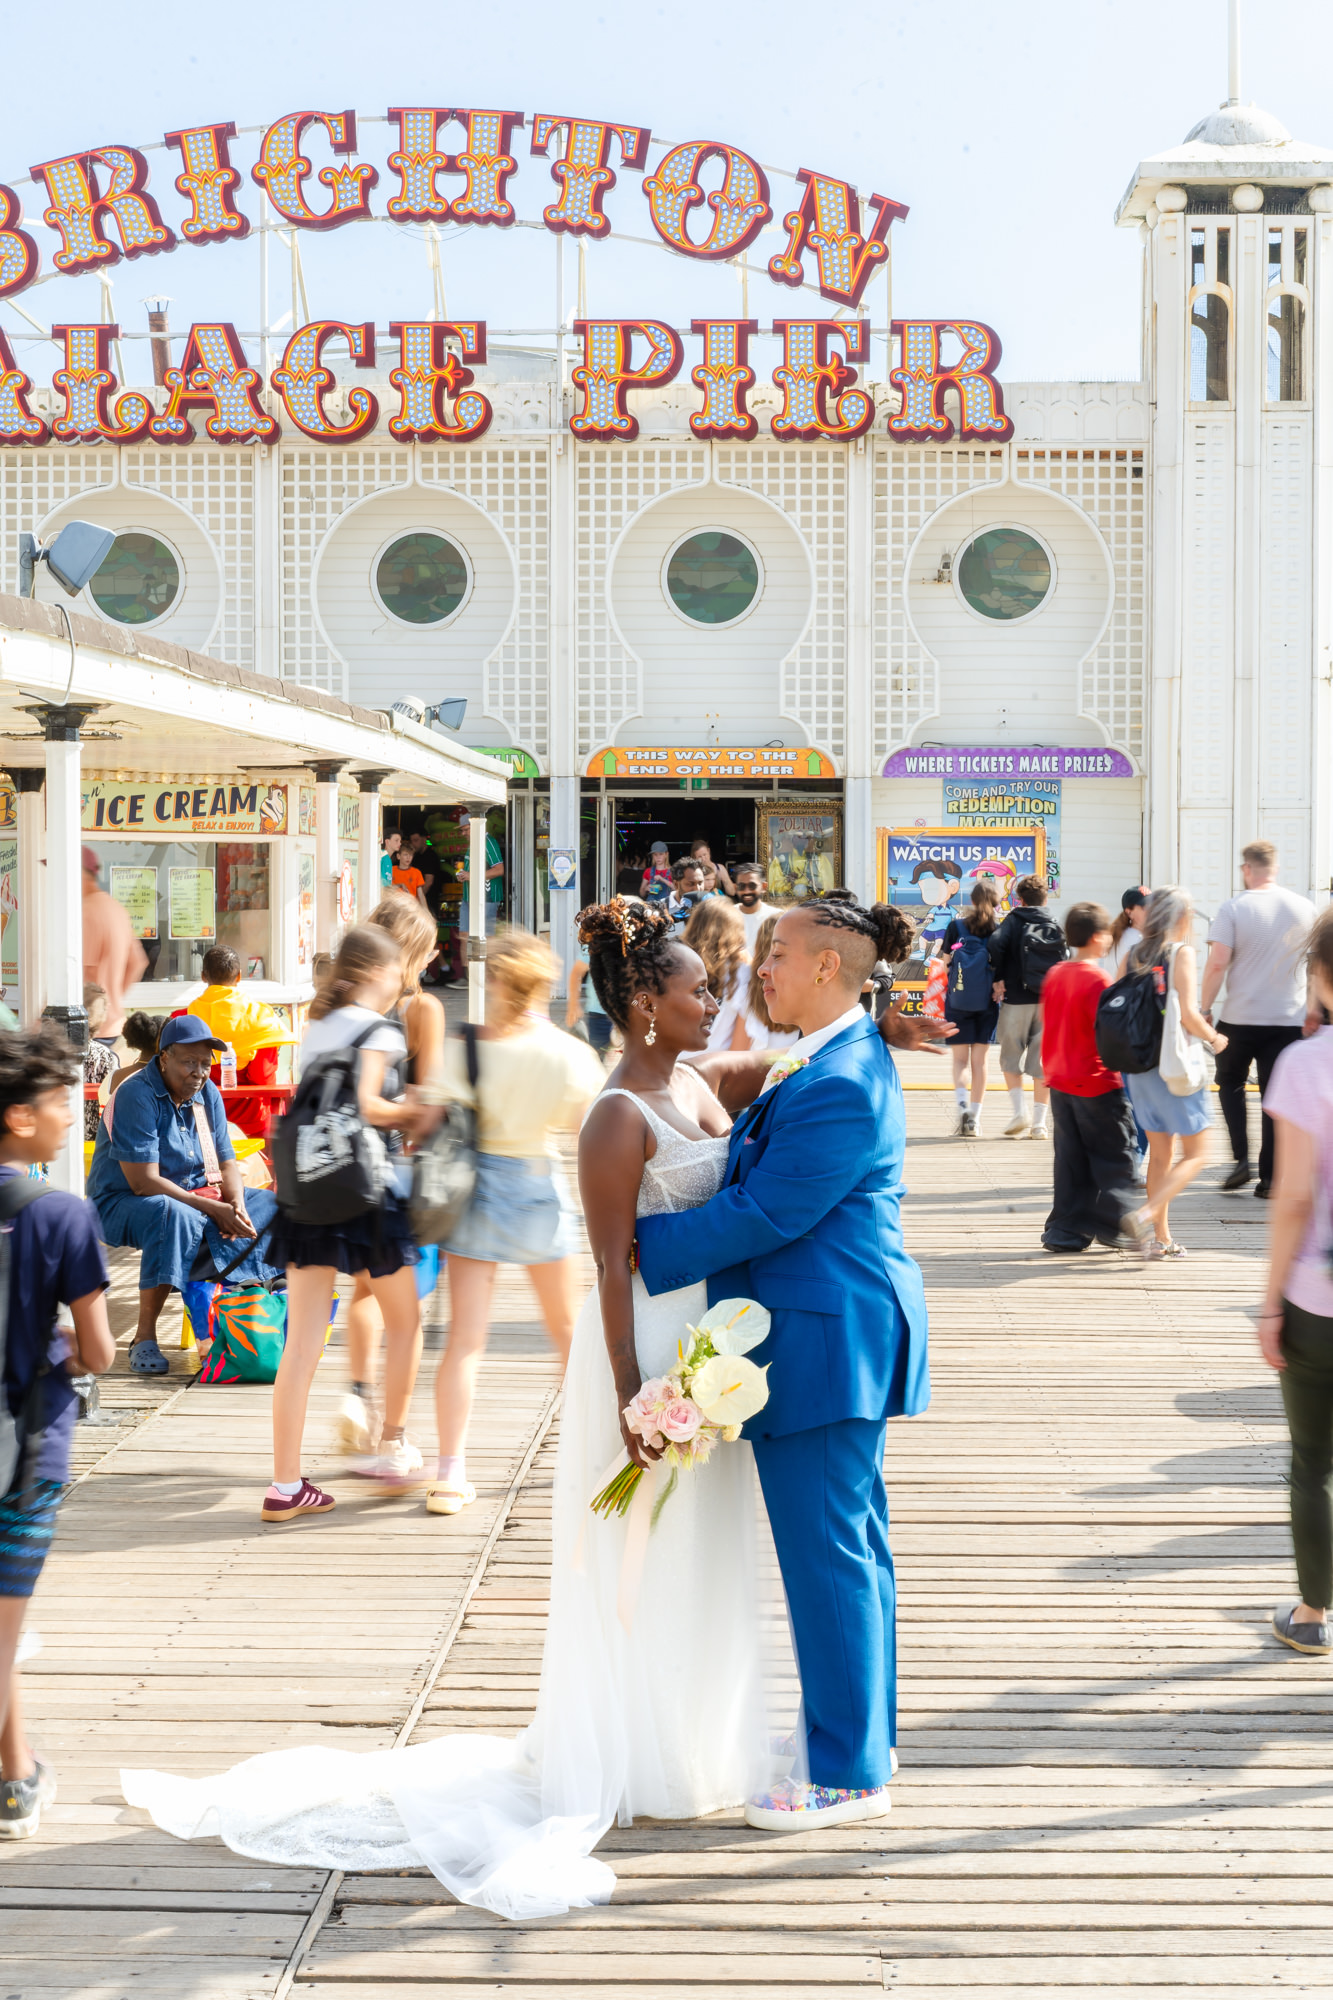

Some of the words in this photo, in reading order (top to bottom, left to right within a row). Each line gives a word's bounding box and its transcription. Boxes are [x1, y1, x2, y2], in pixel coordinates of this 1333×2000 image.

[569, 319, 1015, 444] PIER
[624, 751, 668, 761] THIS
[674, 751, 721, 761] WAY
[727, 751, 754, 761] TO
[761, 751, 798, 761] THE
[905, 756, 954, 773] WHERE
[958, 756, 1013, 773] TICKETS
[1019, 756, 1059, 773] MAKE
[1064, 756, 1113, 773] PRIZES
[628, 765, 670, 775] END
[675, 765, 702, 775] OF
[705, 765, 744, 775] THE
[751, 765, 794, 775] PIER
[946, 785, 979, 799] COME
[982, 784, 1007, 798] AND
[1009, 781, 1032, 794] TRY
[1034, 780, 1059, 795] OUR
[93, 794, 146, 830] ICE
[153, 785, 258, 824] CREAM
[947, 796, 1056, 815] REDEMPTION
[192, 821, 216, 830] RELAX
[218, 822, 223, 830] &
[225, 821, 255, 831] ENJOY!
[778, 816, 825, 835] ZOLTAR
[958, 815, 1045, 827] MACHINES
[893, 847, 955, 862] WATCH
[959, 847, 982, 862] US
[986, 847, 1032, 862] PLAY!
